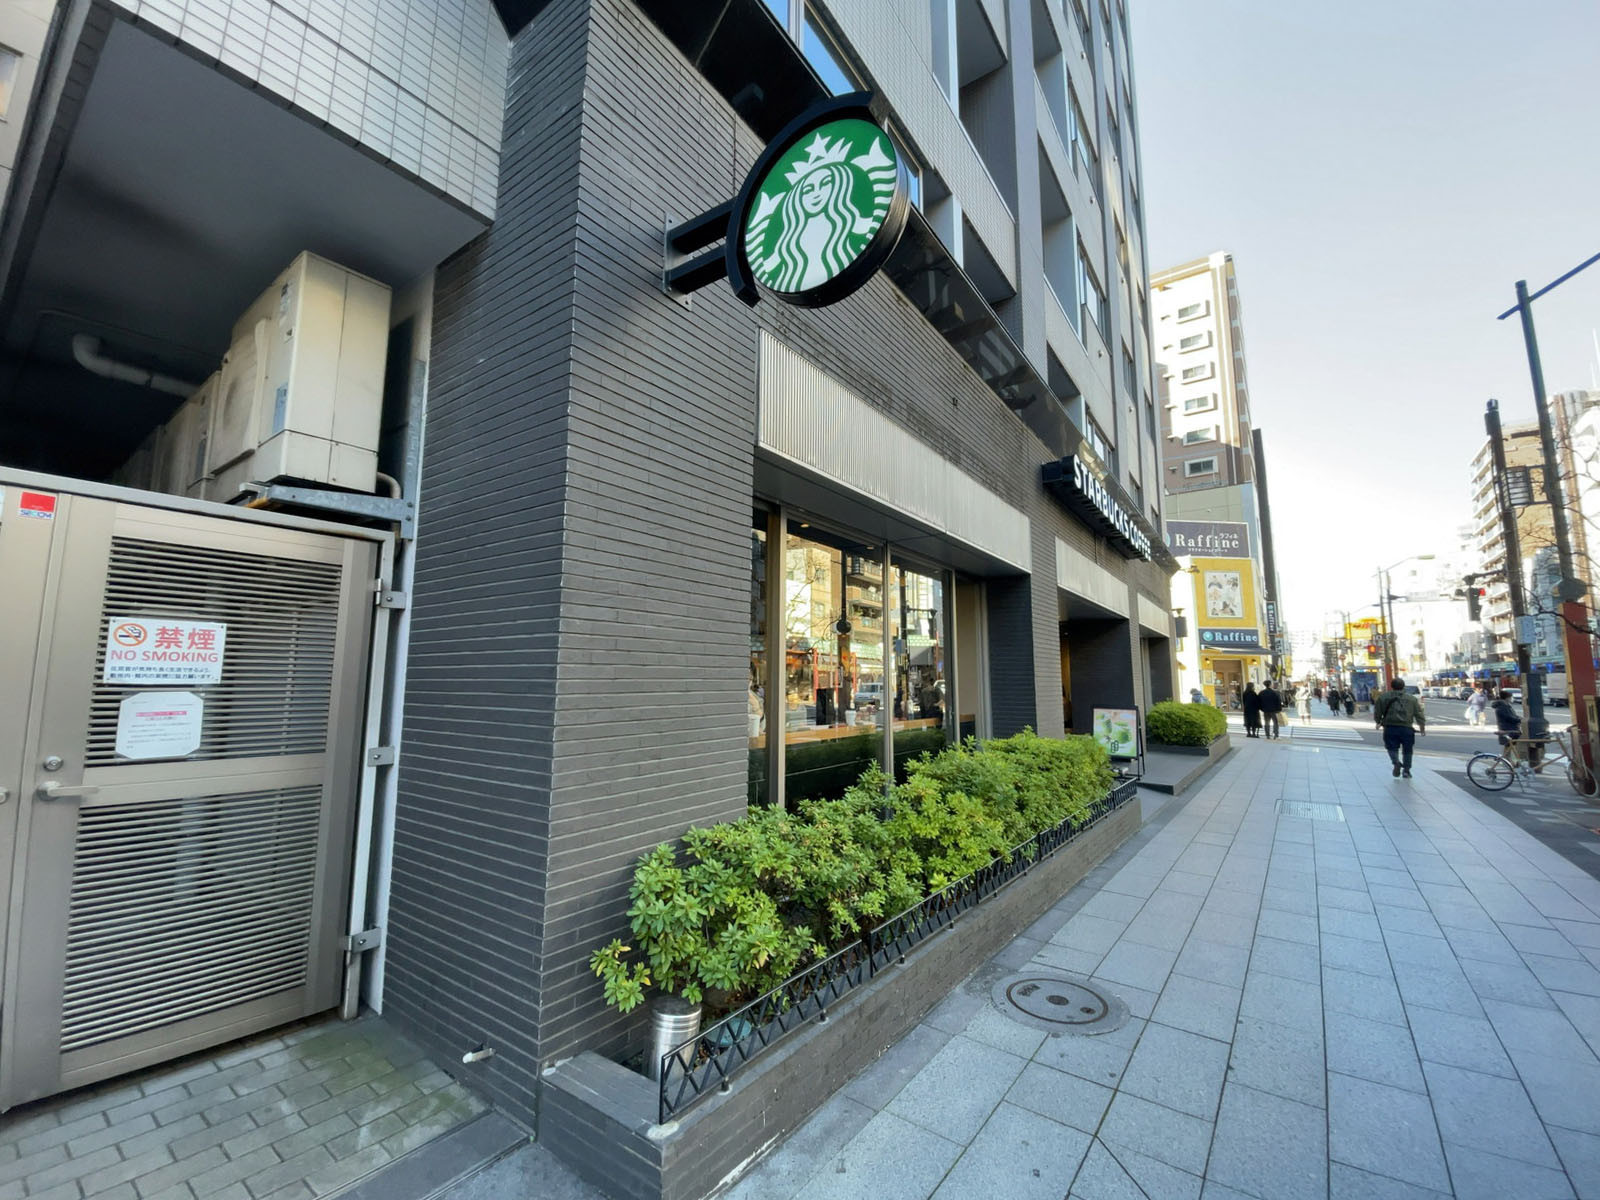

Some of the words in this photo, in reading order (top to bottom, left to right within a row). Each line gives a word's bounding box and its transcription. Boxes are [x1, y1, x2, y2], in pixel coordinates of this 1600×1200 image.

[1073, 453, 1129, 540] STARBUCKS
[1129, 519, 1151, 562] COFFEE
[1175, 533, 1240, 549] Raffine
[154, 626, 217, 651] 禁煙
[1214, 631, 1258, 642] Raffine
[110, 649, 137, 662] NO
[142, 650, 219, 663] SMOKING
